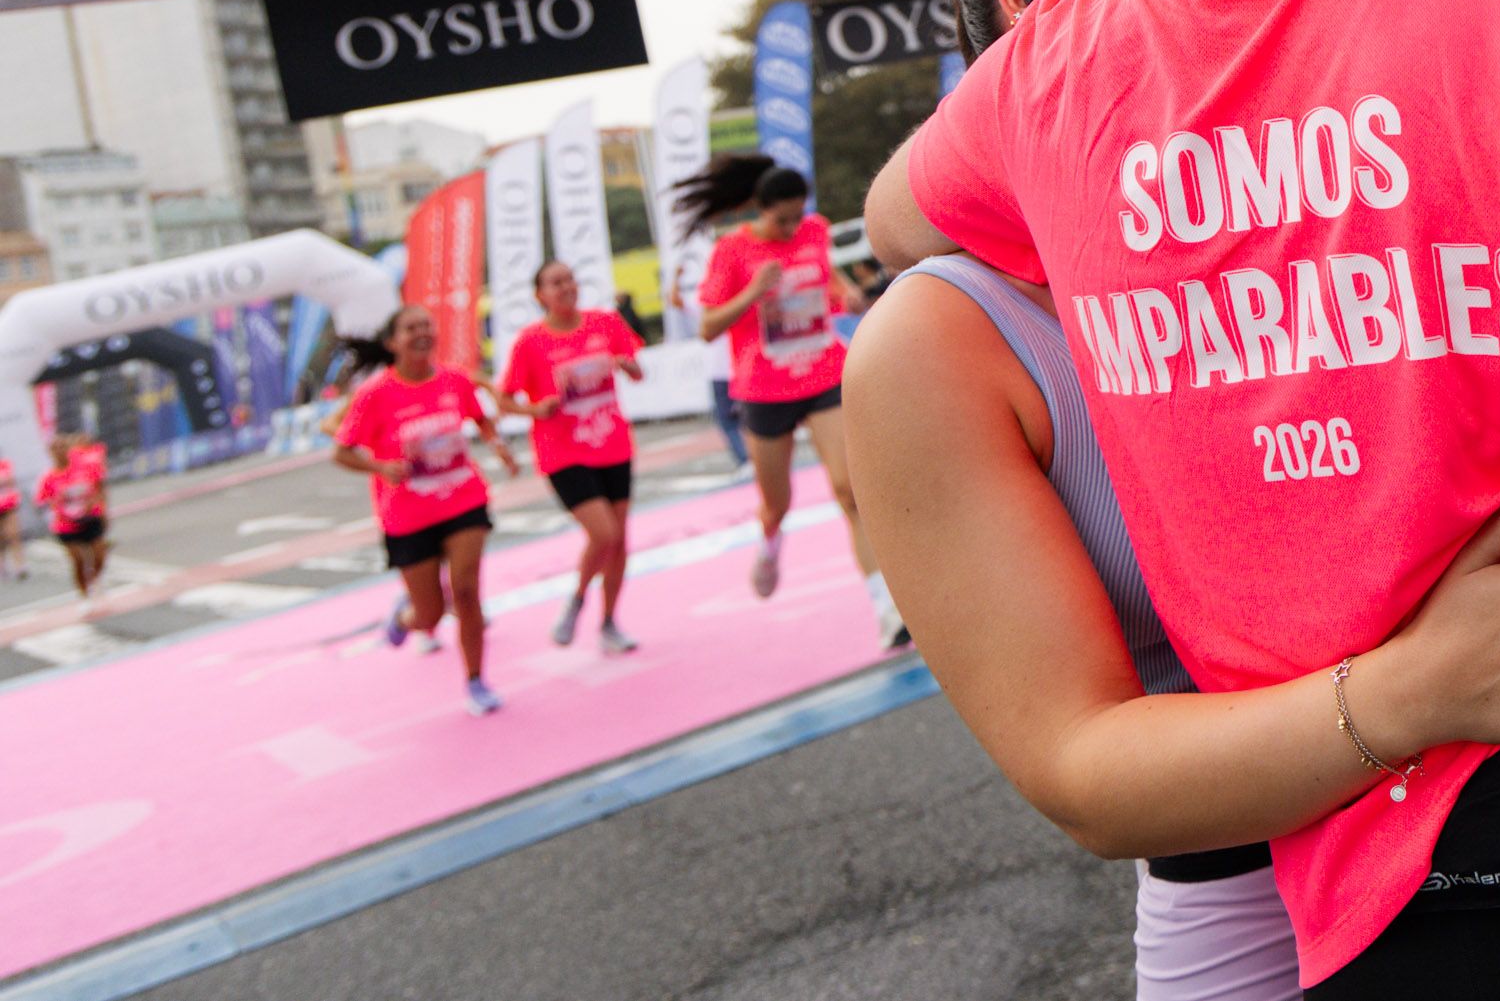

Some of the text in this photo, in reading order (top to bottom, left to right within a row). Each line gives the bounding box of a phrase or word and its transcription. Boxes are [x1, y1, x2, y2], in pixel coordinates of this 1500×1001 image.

[1118, 94, 1409, 252] SOMOS
[85, 260, 265, 325] OYSHO
[1253, 417, 1361, 482] 2026
